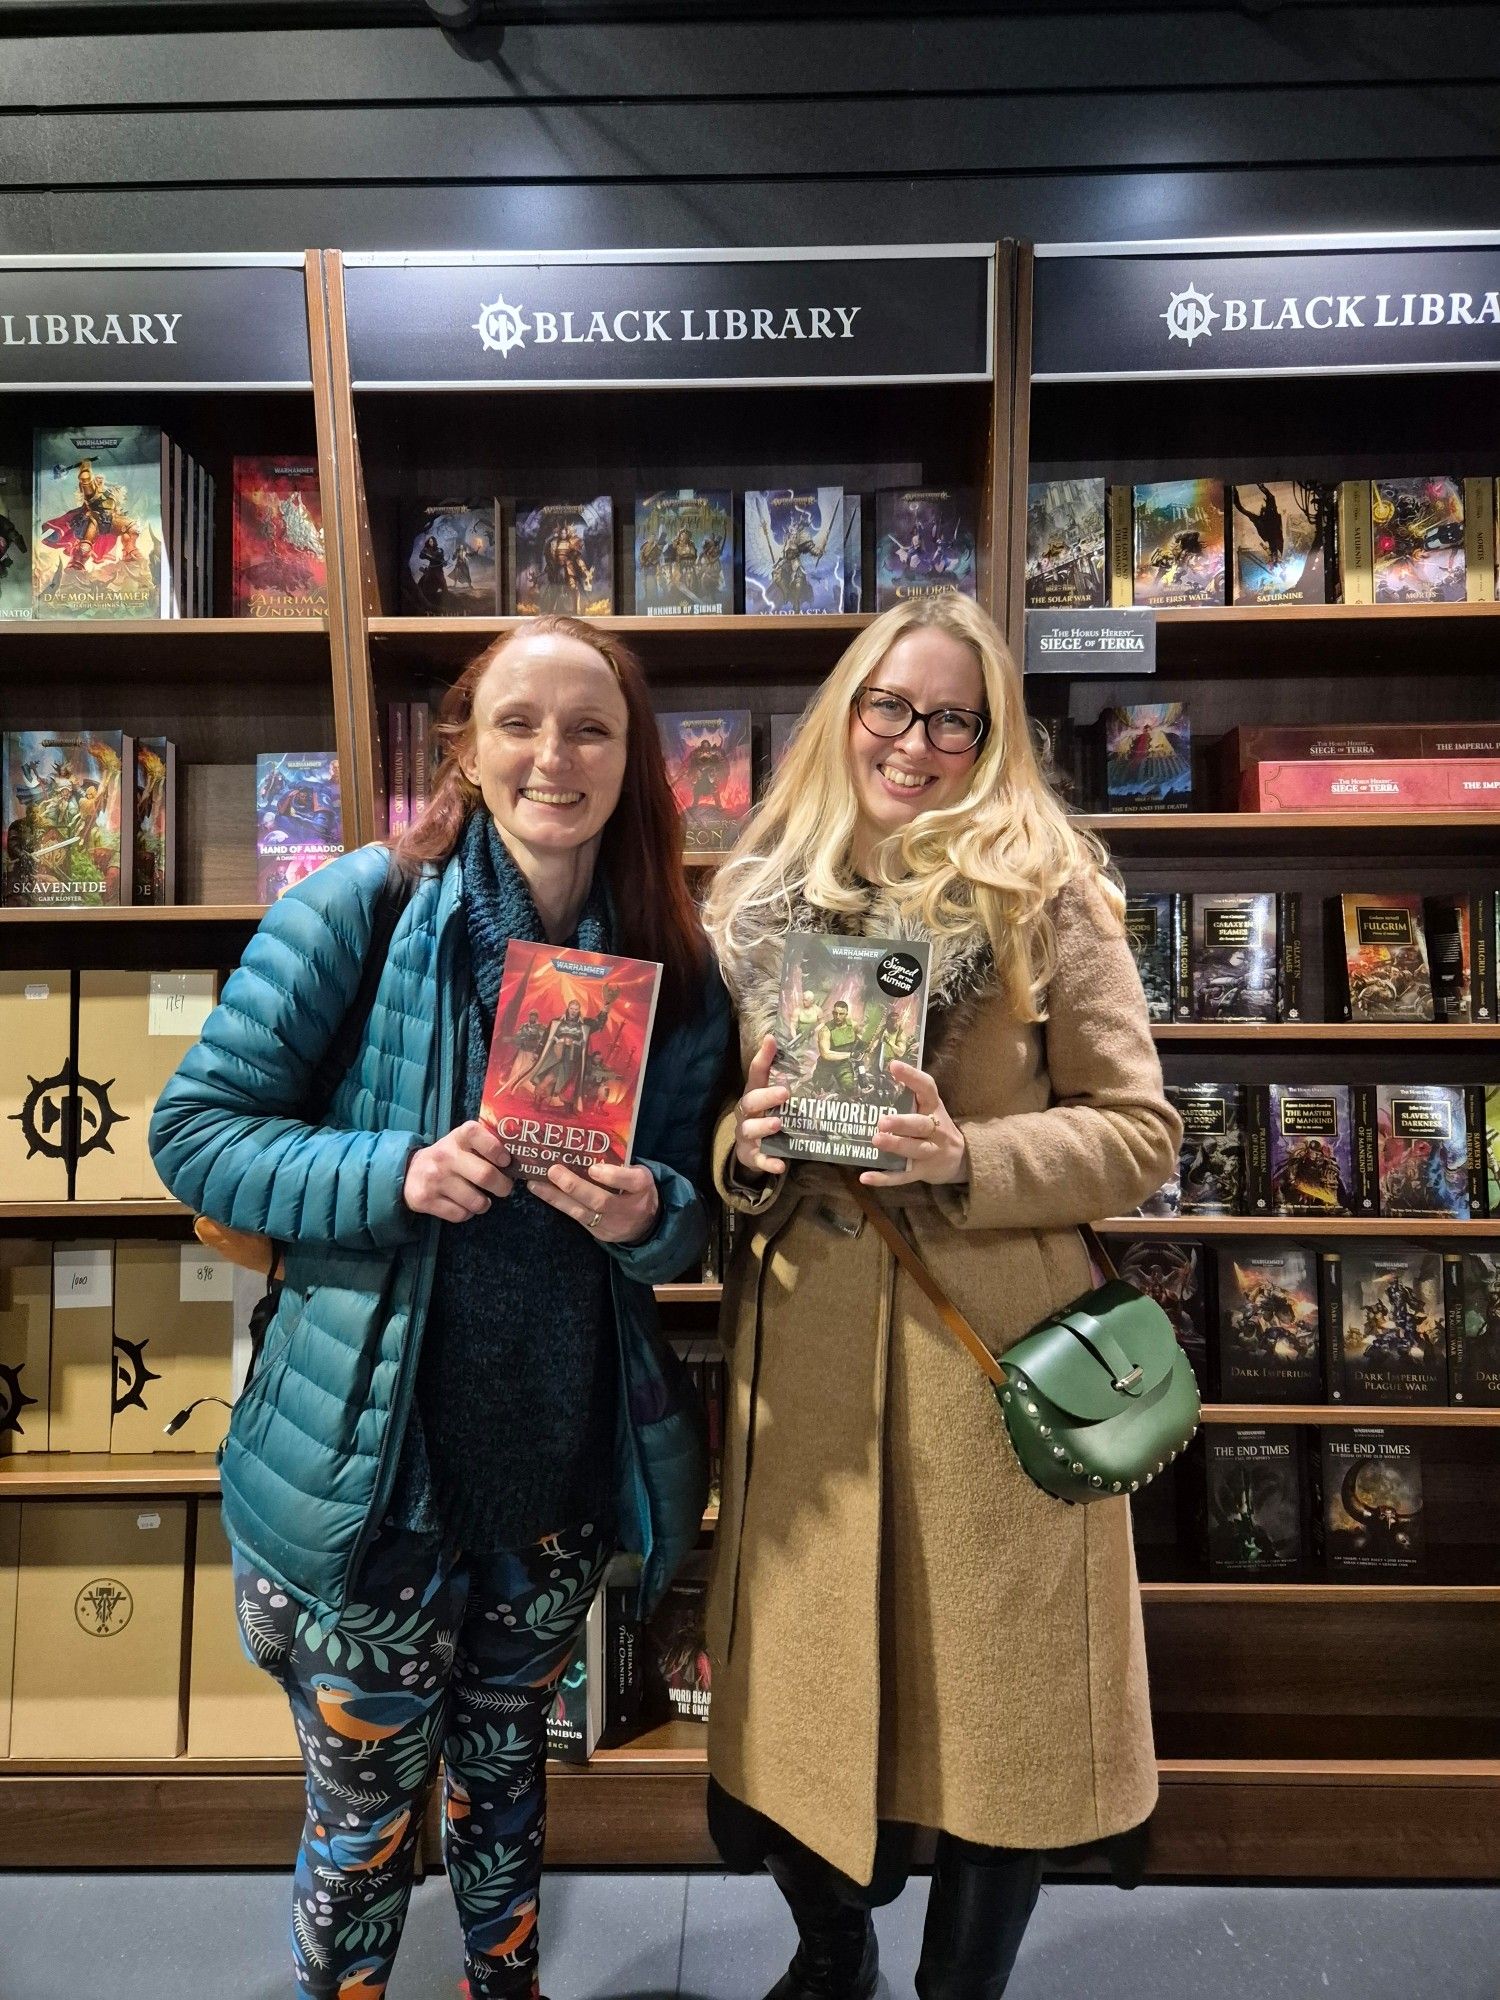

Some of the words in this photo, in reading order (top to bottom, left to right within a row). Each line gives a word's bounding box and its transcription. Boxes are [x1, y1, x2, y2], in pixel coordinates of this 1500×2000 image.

[1221, 294, 1366, 331] BLACK
[1374, 291, 1500, 327] LIBRA
[1, 313, 182, 346] LIBRARY
[532, 309, 672, 344] BLACK
[680, 306, 862, 341] LIBRARY
[43, 592, 149, 602] DAEMONHAMMER
[1073, 594, 1092, 602] WAR
[1165, 595, 1188, 603] FIRST
[1256, 590, 1304, 602] SATURNINE
[1052, 628, 1069, 637] THE
[1071, 628, 1098, 637] HORUS
[1101, 627, 1132, 638] HERESY
[1040, 638, 1081, 650] SIEGE
[1085, 640, 1096, 648] OF
[1099, 638, 1145, 650] TERRA
[1347, 746, 1375, 754] TERRA
[1436, 743, 1453, 751] THE
[1454, 742, 1495, 750] IMPERIAL
[1331, 784, 1358, 793] SIEGE
[1368, 784, 1399, 792] TERRA
[1463, 781, 1481, 790] THE
[259, 845, 288, 854] HAND
[289, 845, 303, 853] OF
[12, 881, 107, 895] SKAVENTIDE
[1363, 922, 1407, 931] FULGRIM
[832, 948, 879, 958] WARHAMMER
[1477, 940, 1486, 975] FULGRIM
[557, 960, 605, 975] WARHAMMER
[883, 956, 920, 977] Signed
[880, 973, 912, 992] AUTHOR
[1285, 1109, 1301, 1117] THE
[1302, 1109, 1332, 1117] MASTER
[1401, 1112, 1428, 1120] SLAVES
[791, 1117, 818, 1131] ASTRA
[819, 1121, 866, 1136] MILITARUM
[497, 1116, 611, 1154] CREED
[504, 1143, 539, 1159] SHES
[540, 1149, 561, 1161] OF
[789, 1138, 831, 1155] VICTORIA
[833, 1143, 879, 1160] HAYWARD
[519, 1163, 547, 1176] JUDE
[1231, 1366, 1260, 1377] DARK
[1354, 1371, 1384, 1381] DARK
[1404, 1382, 1429, 1392] WAR
[1213, 1446, 1235, 1456] THE
[1237, 1446, 1258, 1456] END
[1260, 1444, 1290, 1456] TIMES
[1328, 1442, 1351, 1453] THE
[1353, 1443, 1376, 1454] END
[1378, 1444, 1411, 1455] TIMES
[668, 1687, 692, 1703] WORD
[678, 1702, 691, 1715] THE
